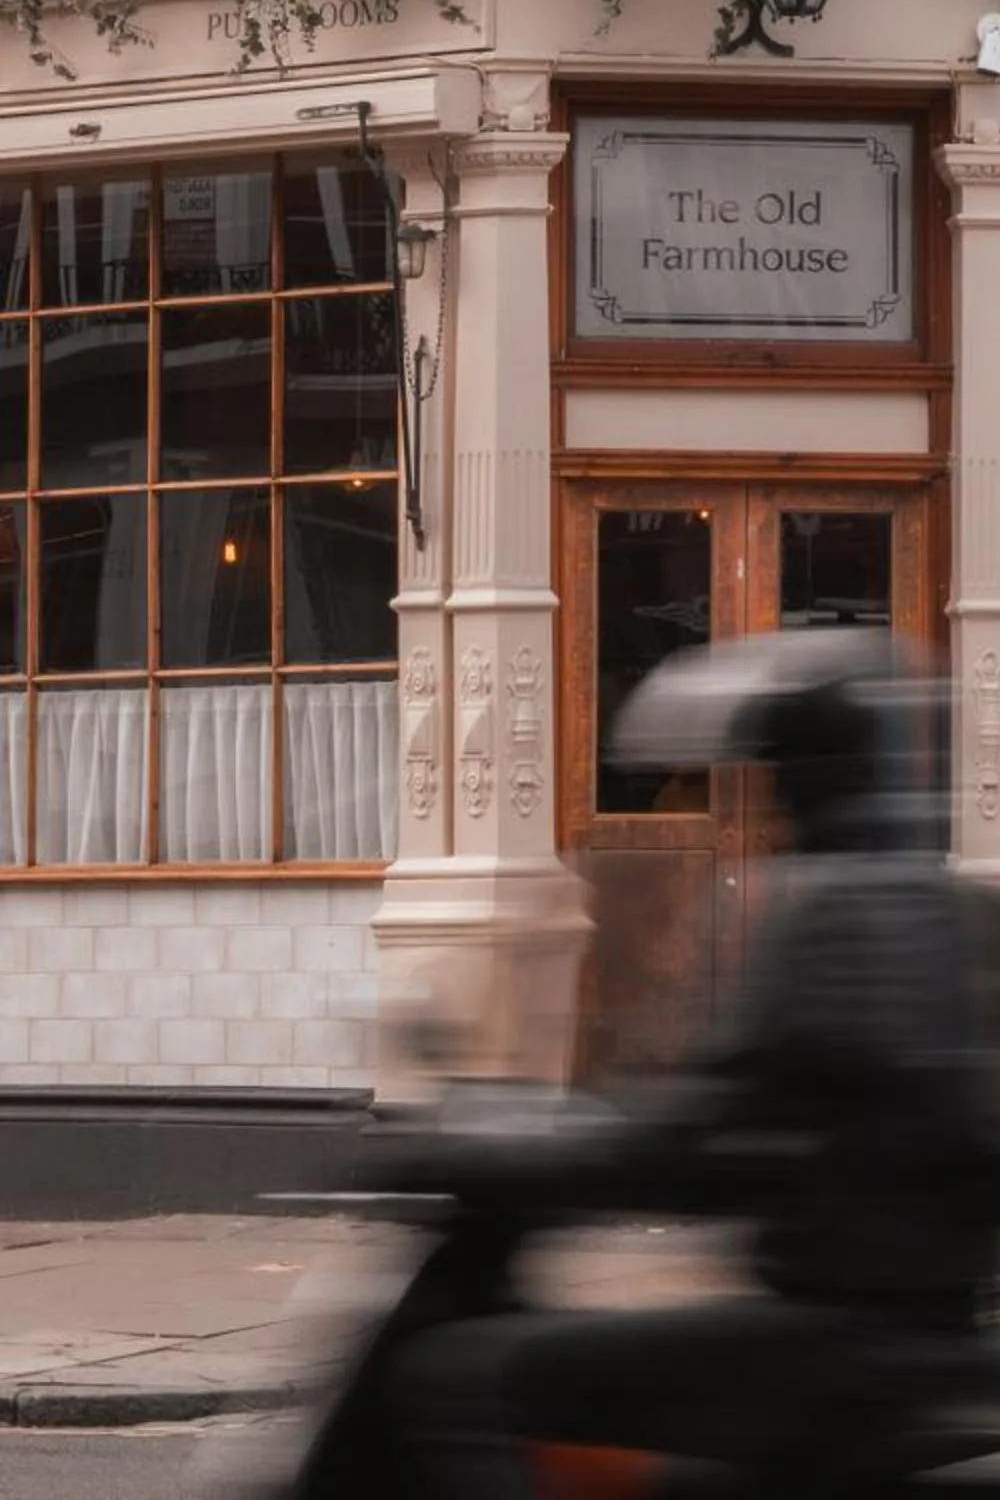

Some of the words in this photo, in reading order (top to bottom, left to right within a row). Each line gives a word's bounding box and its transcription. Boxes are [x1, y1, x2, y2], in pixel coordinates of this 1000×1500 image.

[207, 9, 258, 40] PU
[668, 189, 740, 224] The
[754, 191, 822, 225] Old
[641, 237, 850, 273] Farmhouse
